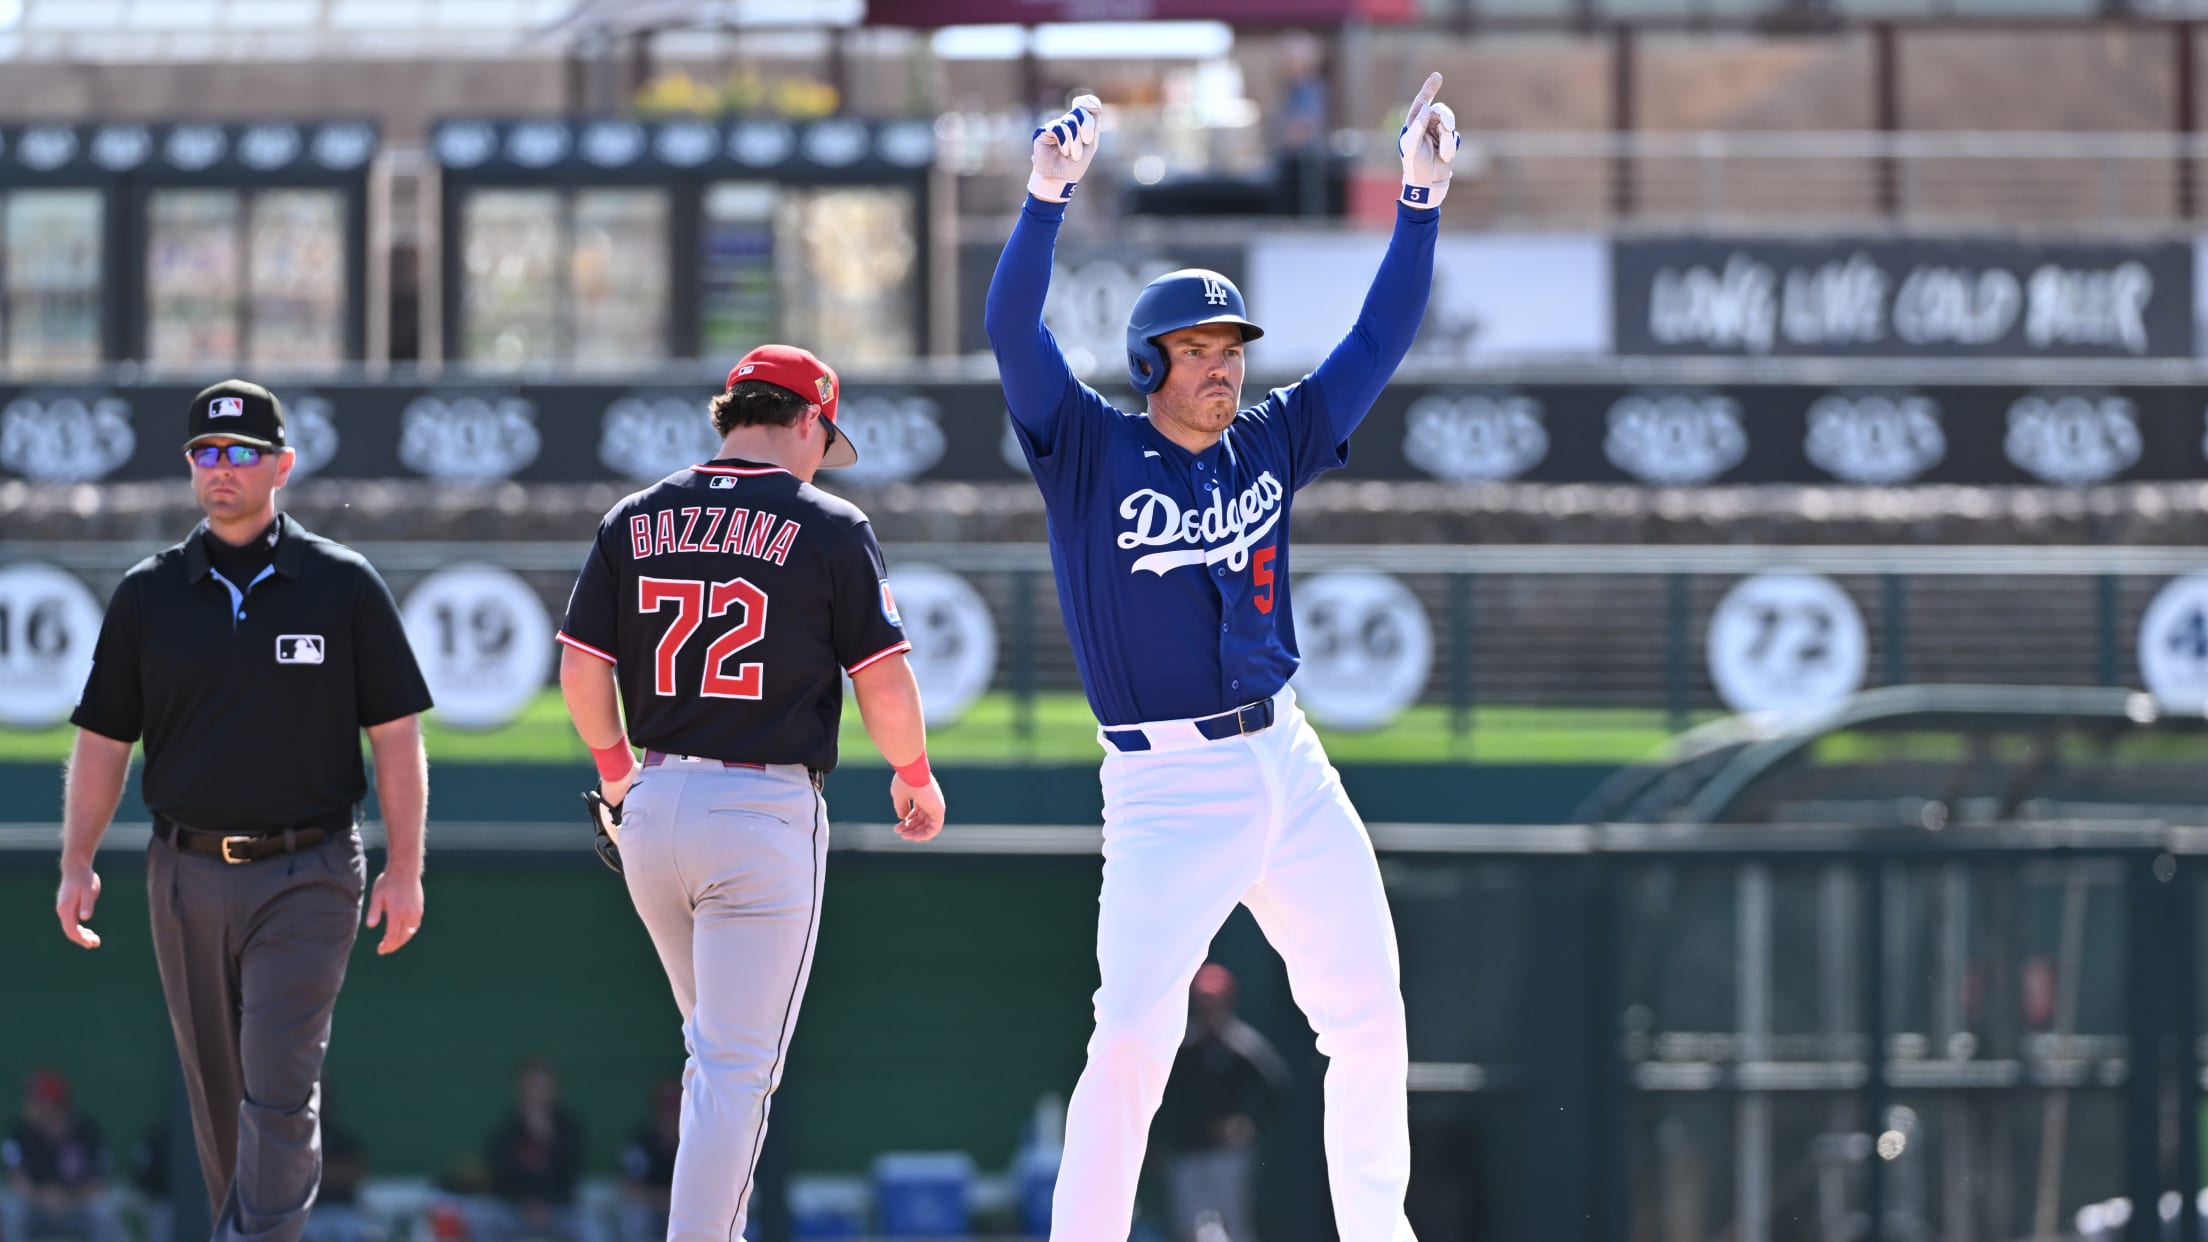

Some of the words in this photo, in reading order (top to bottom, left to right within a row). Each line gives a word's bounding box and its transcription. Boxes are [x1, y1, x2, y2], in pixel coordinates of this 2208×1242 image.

[1410, 188, 1421, 201] 5
[1200, 275, 1228, 306] LA
[630, 507, 800, 566] BAZZANA
[1117, 470, 1283, 577] Dodgers
[1253, 545, 1276, 615] 5
[434, 601, 516, 657] 19
[638, 575, 768, 700] 72
[1747, 602, 1833, 663] 72
